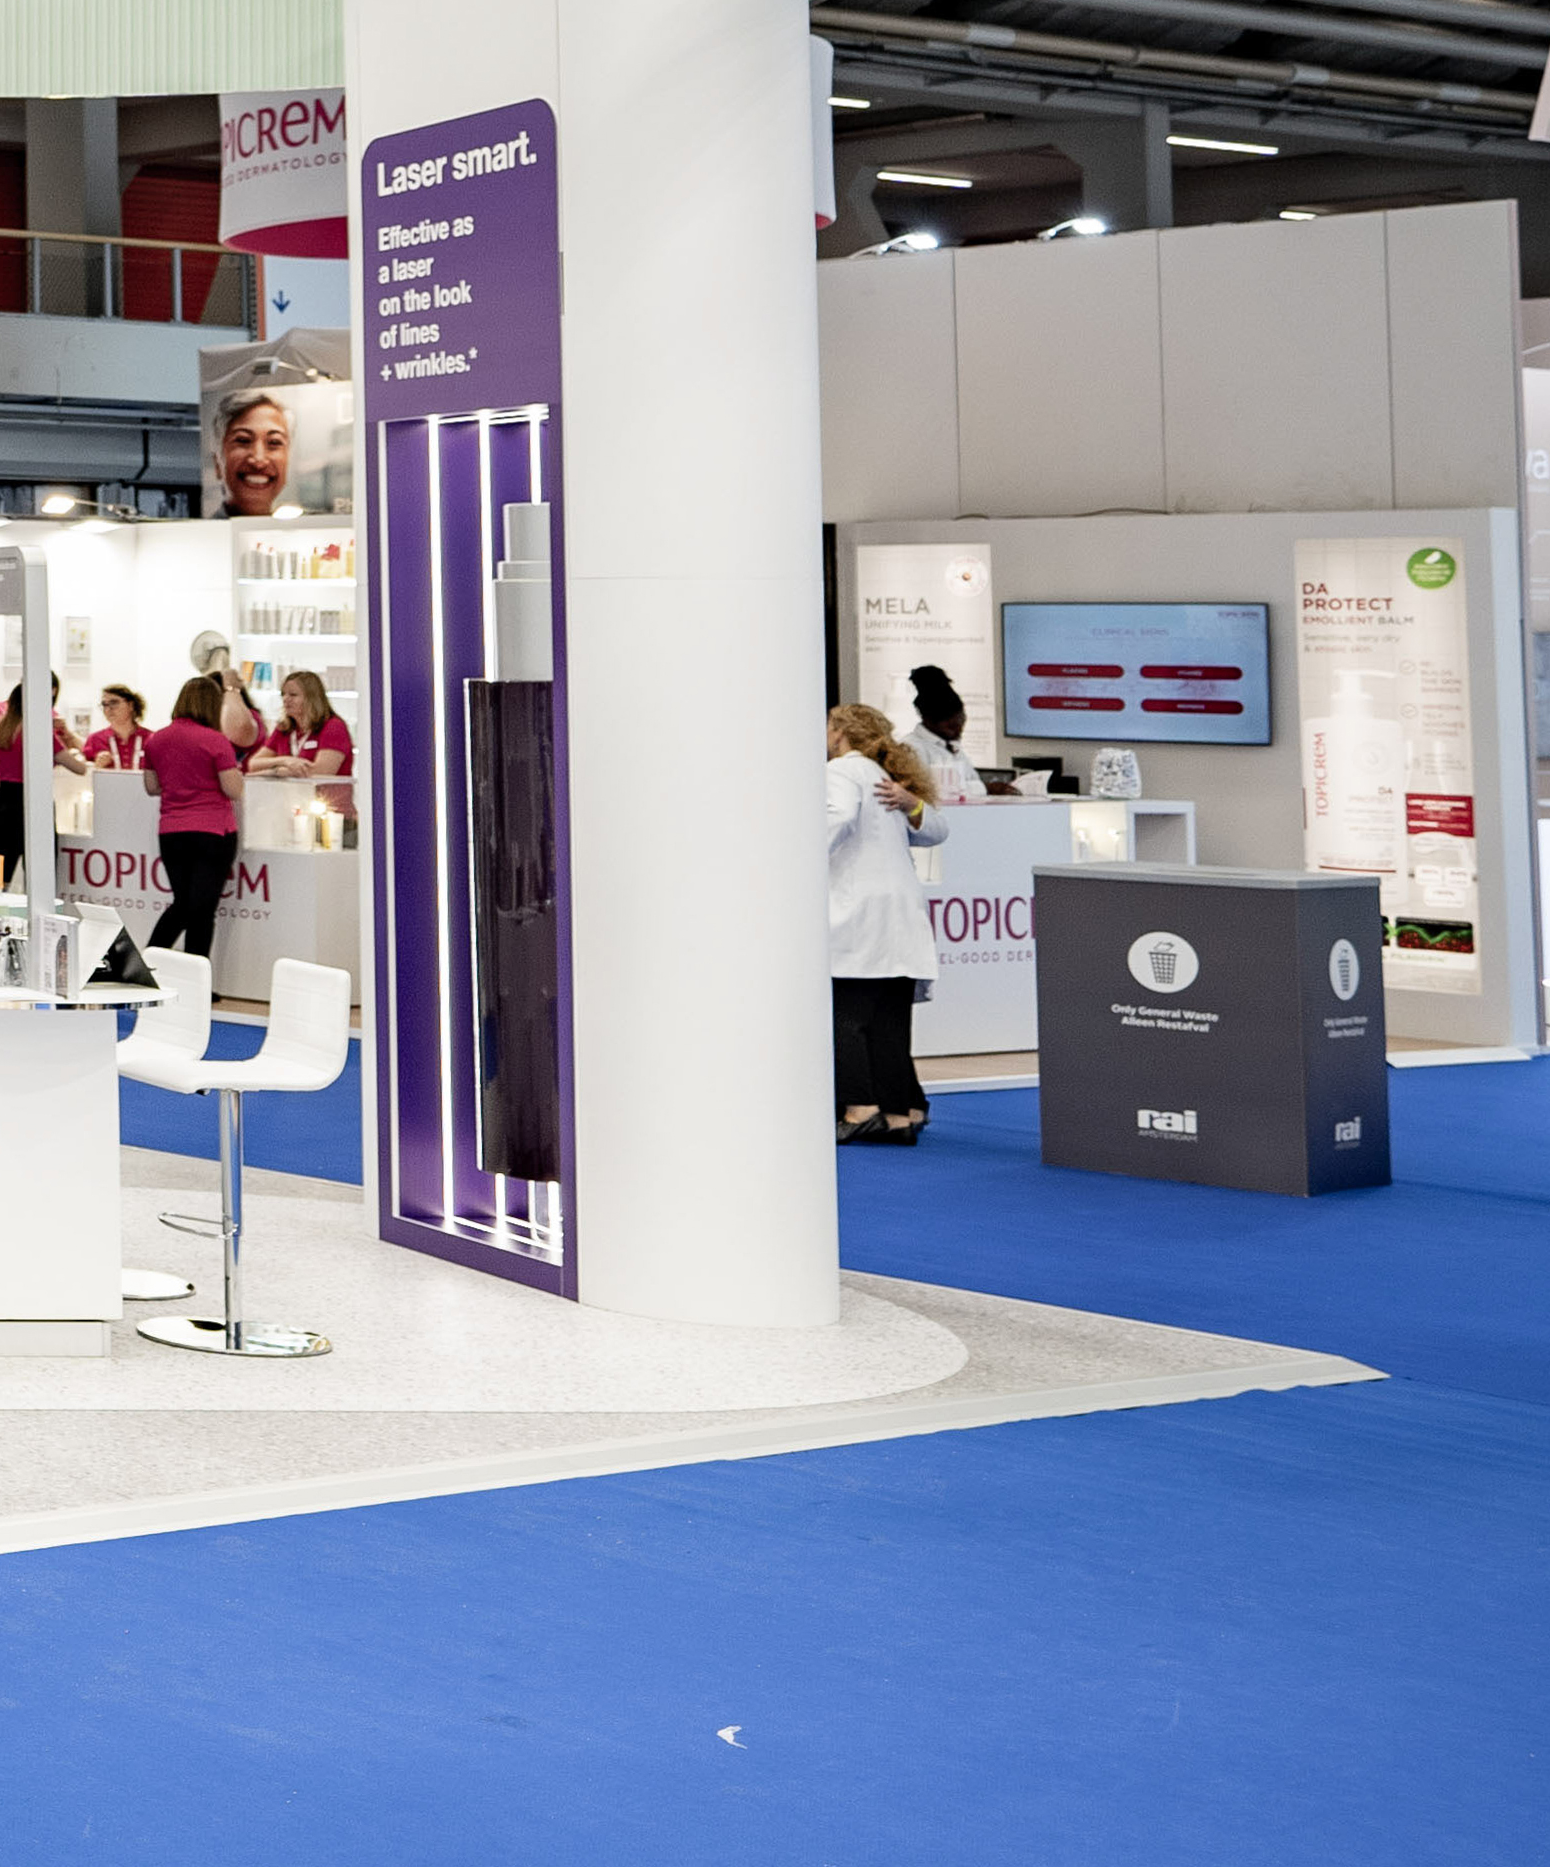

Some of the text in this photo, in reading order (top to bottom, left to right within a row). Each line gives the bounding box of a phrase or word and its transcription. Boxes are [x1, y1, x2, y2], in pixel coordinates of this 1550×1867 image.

[377, 130, 537, 198] Laser smart.
[378, 215, 474, 251] Effective as
[378, 255, 435, 284] a laser
[379, 279, 472, 316] on the look
[379, 320, 440, 349] of lines
[1302, 583, 1329, 595] DA
[866, 598, 930, 615] MELA
[1302, 598, 1393, 611] PROTECT
[1111, 1003, 1219, 1022] Only General Waste
[1137, 1109, 1198, 1134] rai
[1335, 1116, 1361, 1142] rai
